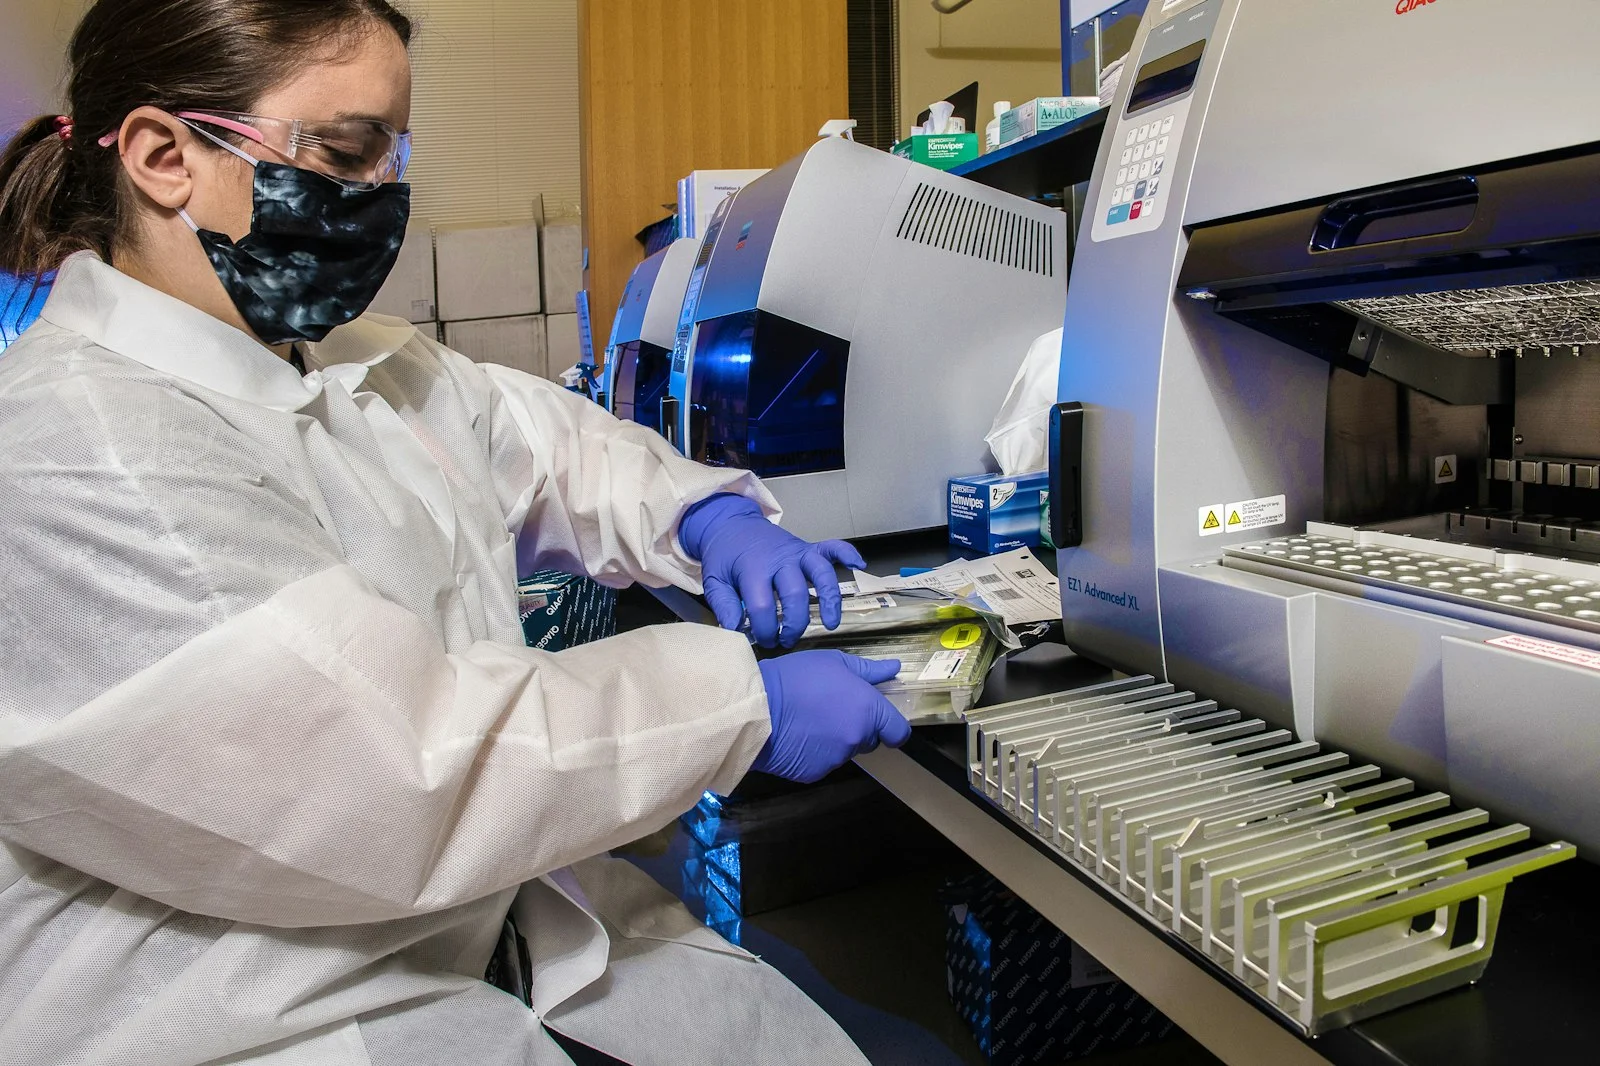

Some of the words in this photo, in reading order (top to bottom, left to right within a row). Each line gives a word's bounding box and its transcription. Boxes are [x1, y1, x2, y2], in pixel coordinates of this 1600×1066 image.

[1395, 0, 1436, 14] QIA
[928, 142, 964, 151] Kimwipes
[1132, 203, 1141, 211] STOP
[951, 492, 984, 510] Kimwipes
[993, 488, 998, 500] 2
[1068, 577, 1081, 592] EZ1
[1085, 582, 1125, 606] Advanced
[1127, 594, 1140, 611] XL
[1018, 940, 1040, 967] QIAGEN
[1037, 956, 1060, 982] QIAGEN
[1006, 973, 1031, 999] QIAGEN
[1026, 989, 1049, 1015] QIAGEN
[994, 1006, 1018, 1032] QIAGEN
[1045, 1004, 1068, 1030] QIAGEN
[1014, 1022, 1037, 1048] QIAGEN
